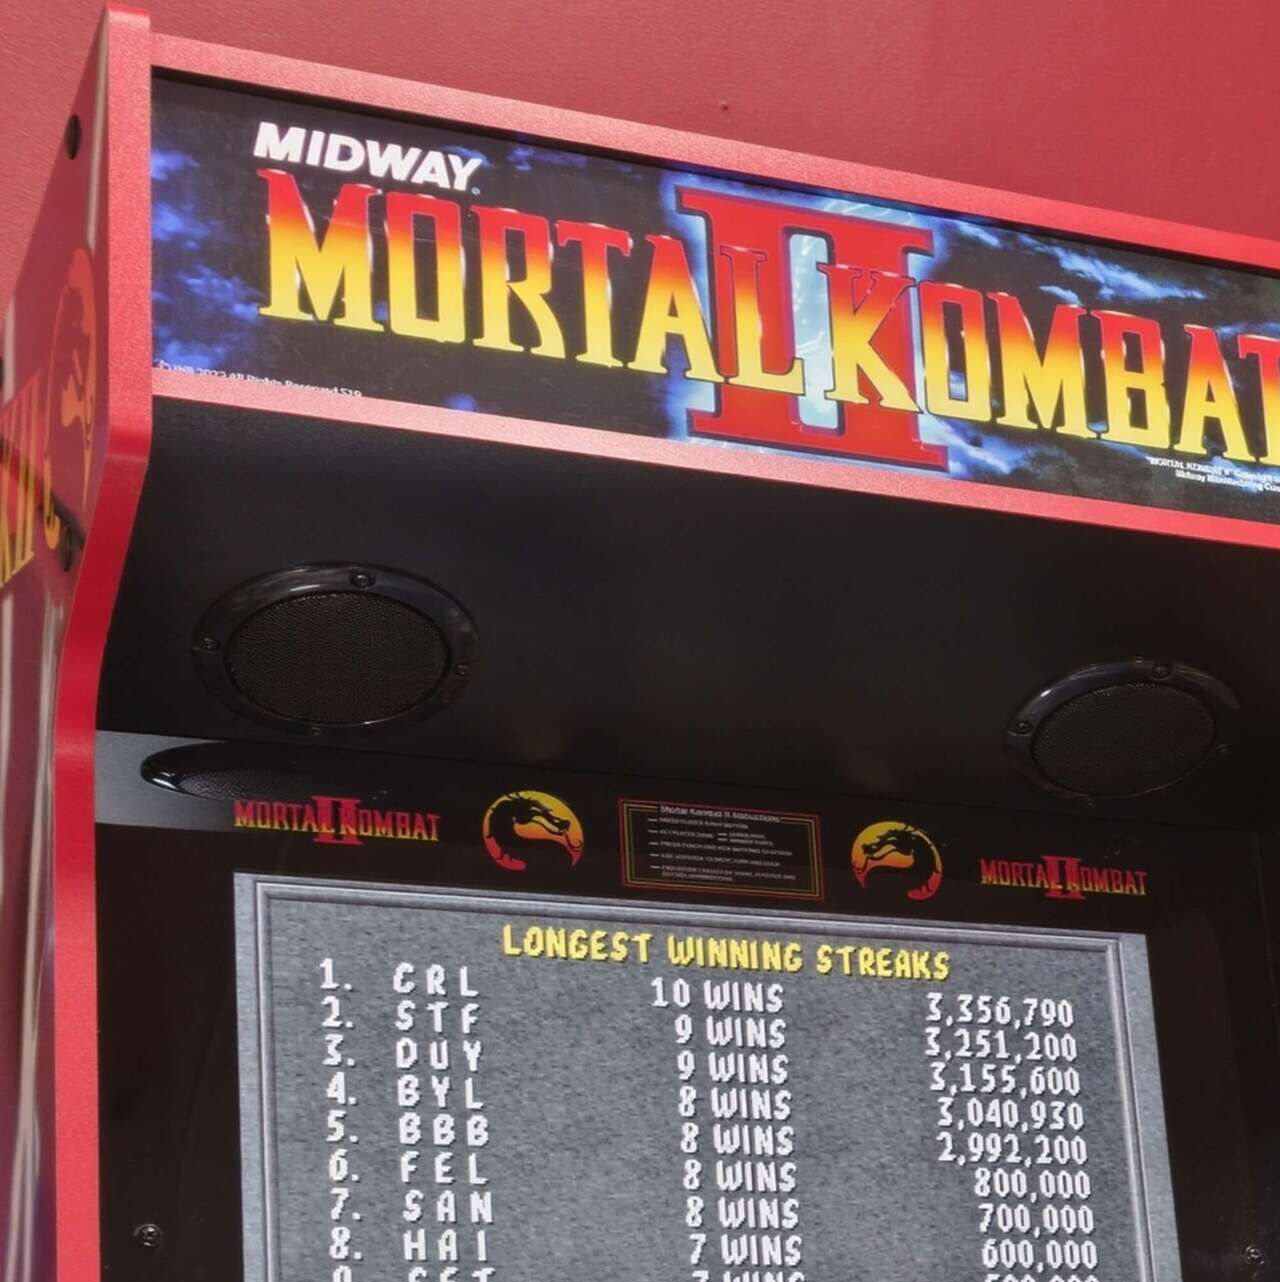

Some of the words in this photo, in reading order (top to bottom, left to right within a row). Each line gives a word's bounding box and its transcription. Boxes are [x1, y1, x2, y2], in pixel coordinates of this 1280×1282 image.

[253, 121, 482, 193] MIDWAY
[257, 168, 805, 397] MORTAL
[502, 923, 652, 965] LONGEST
[667, 936, 803, 974] WINNING
[815, 945, 951, 982] STREAKS
[319, 957, 352, 990] 1.
[651, 977, 690, 1008] 10
[703, 980, 784, 1013] WINS
[926, 992, 1074, 1030] 3,356,790
[321, 995, 353, 1028] 2.
[395, 999, 479, 1034] STF
[674, 1014, 692, 1044] 9
[706, 1015, 786, 1048] WINS
[925, 1026, 1077, 1064] 3,251,200
[322, 1033, 355, 1066] 3.
[396, 1037, 481, 1072] DUY
[677, 1050, 695, 1080] 9
[708, 1052, 789, 1084] WINS
[930, 1061, 1081, 1099] 3,155,600
[326, 1071, 356, 1105] 4.
[397, 1074, 484, 1109] BYL
[678, 1085, 697, 1117] 8
[710, 1087, 792, 1120] WINS
[937, 1096, 1084, 1133] 3,040,930
[328, 1148, 359, 1181] 6.
[400, 1150, 488, 1184] FEL
[683, 1159, 702, 1190] 8
[716, 1160, 797, 1192] WINS
[974, 1167, 1091, 1203] 800,000
[329, 1226, 362, 1260] 8.
[403, 1228, 487, 1261] HAI
[689, 1233, 706, 1265] 7
[720, 1233, 802, 1266] WINS
[981, 1238, 1098, 1273] 600,000
